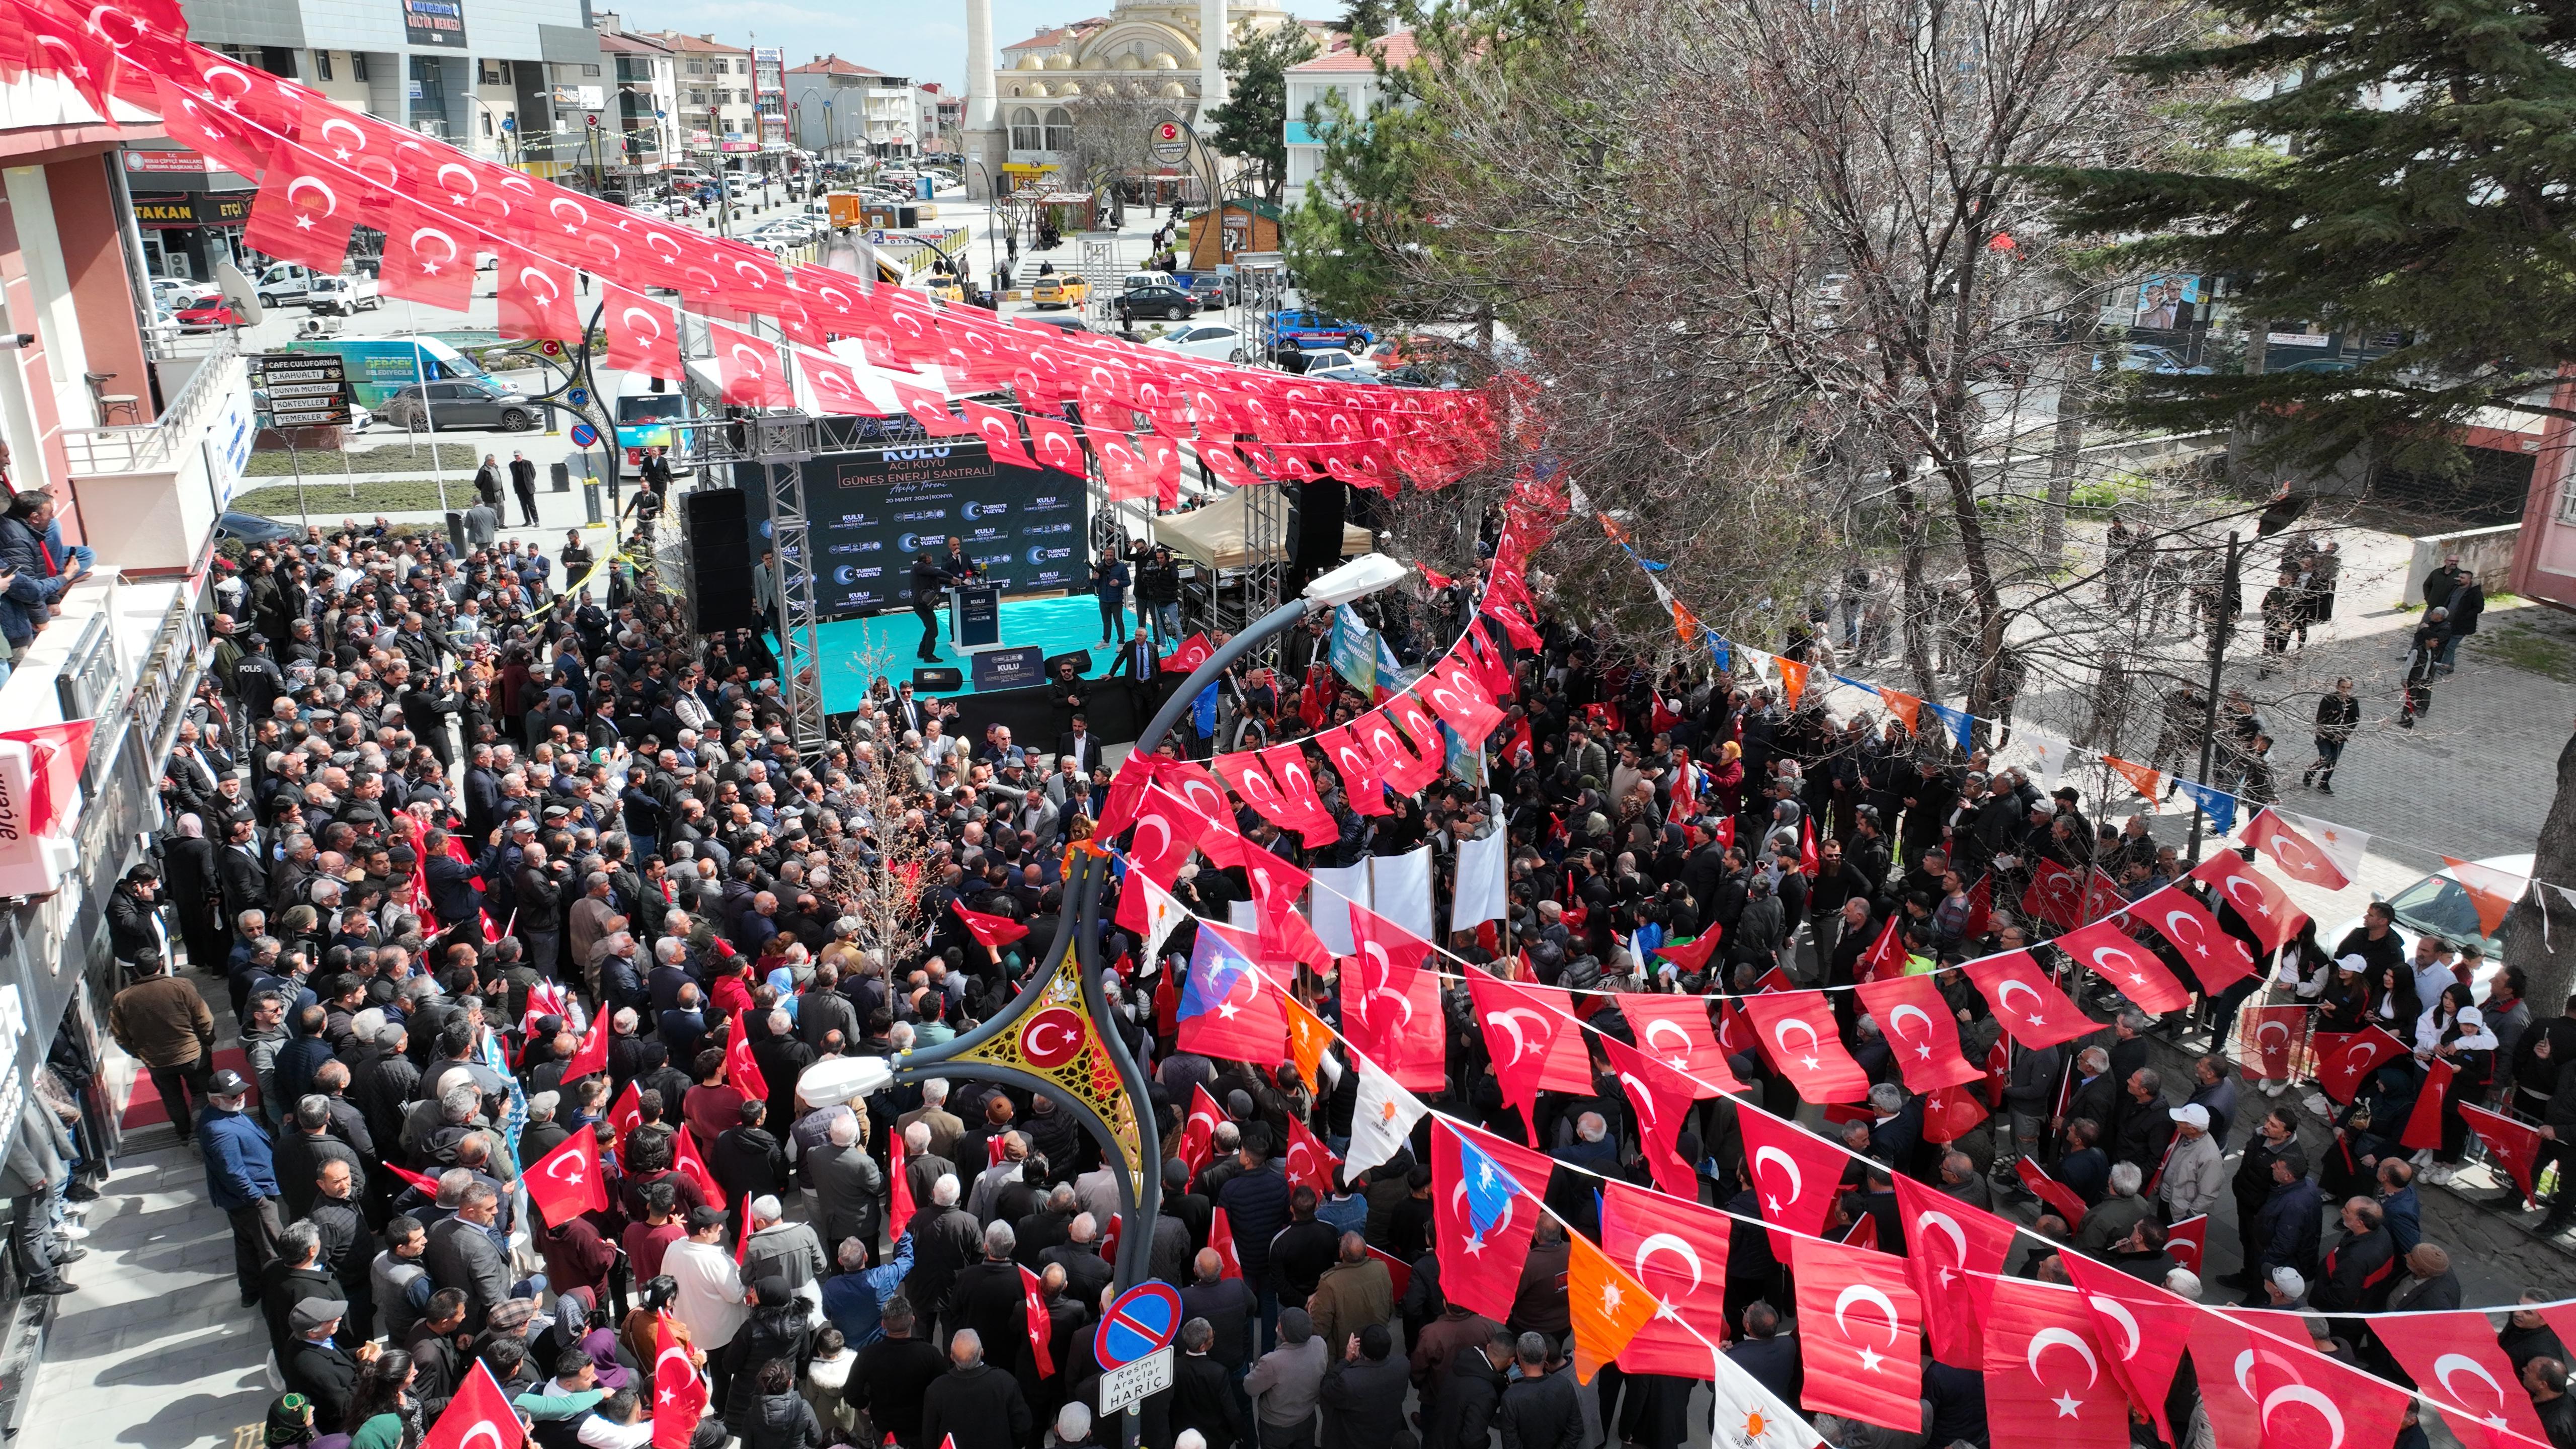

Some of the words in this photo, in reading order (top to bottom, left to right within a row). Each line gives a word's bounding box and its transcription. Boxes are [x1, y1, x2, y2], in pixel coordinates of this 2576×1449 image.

[408, 14, 432, 29] KÜLTÜR
[434, 17, 461, 31] MERKEZİ
[220, 201, 242, 217] ETÇİ
[290, 358, 338, 368] CULUFORNİA
[882, 442, 950, 461] KULU
[889, 462, 909, 471] ACI
[913, 458, 946, 469] KUYU
[842, 474, 884, 486] GÜNEŞ
[888, 470, 930, 481] ENERJİ
[933, 465, 992, 477] SANTRALİ
[997, 663, 1019, 671] KULU
[1117, 1357, 1157, 1380] Resmi
[1113, 1366, 1160, 1392] Araçlar
[1110, 1377, 1162, 1407] HARİÇ
